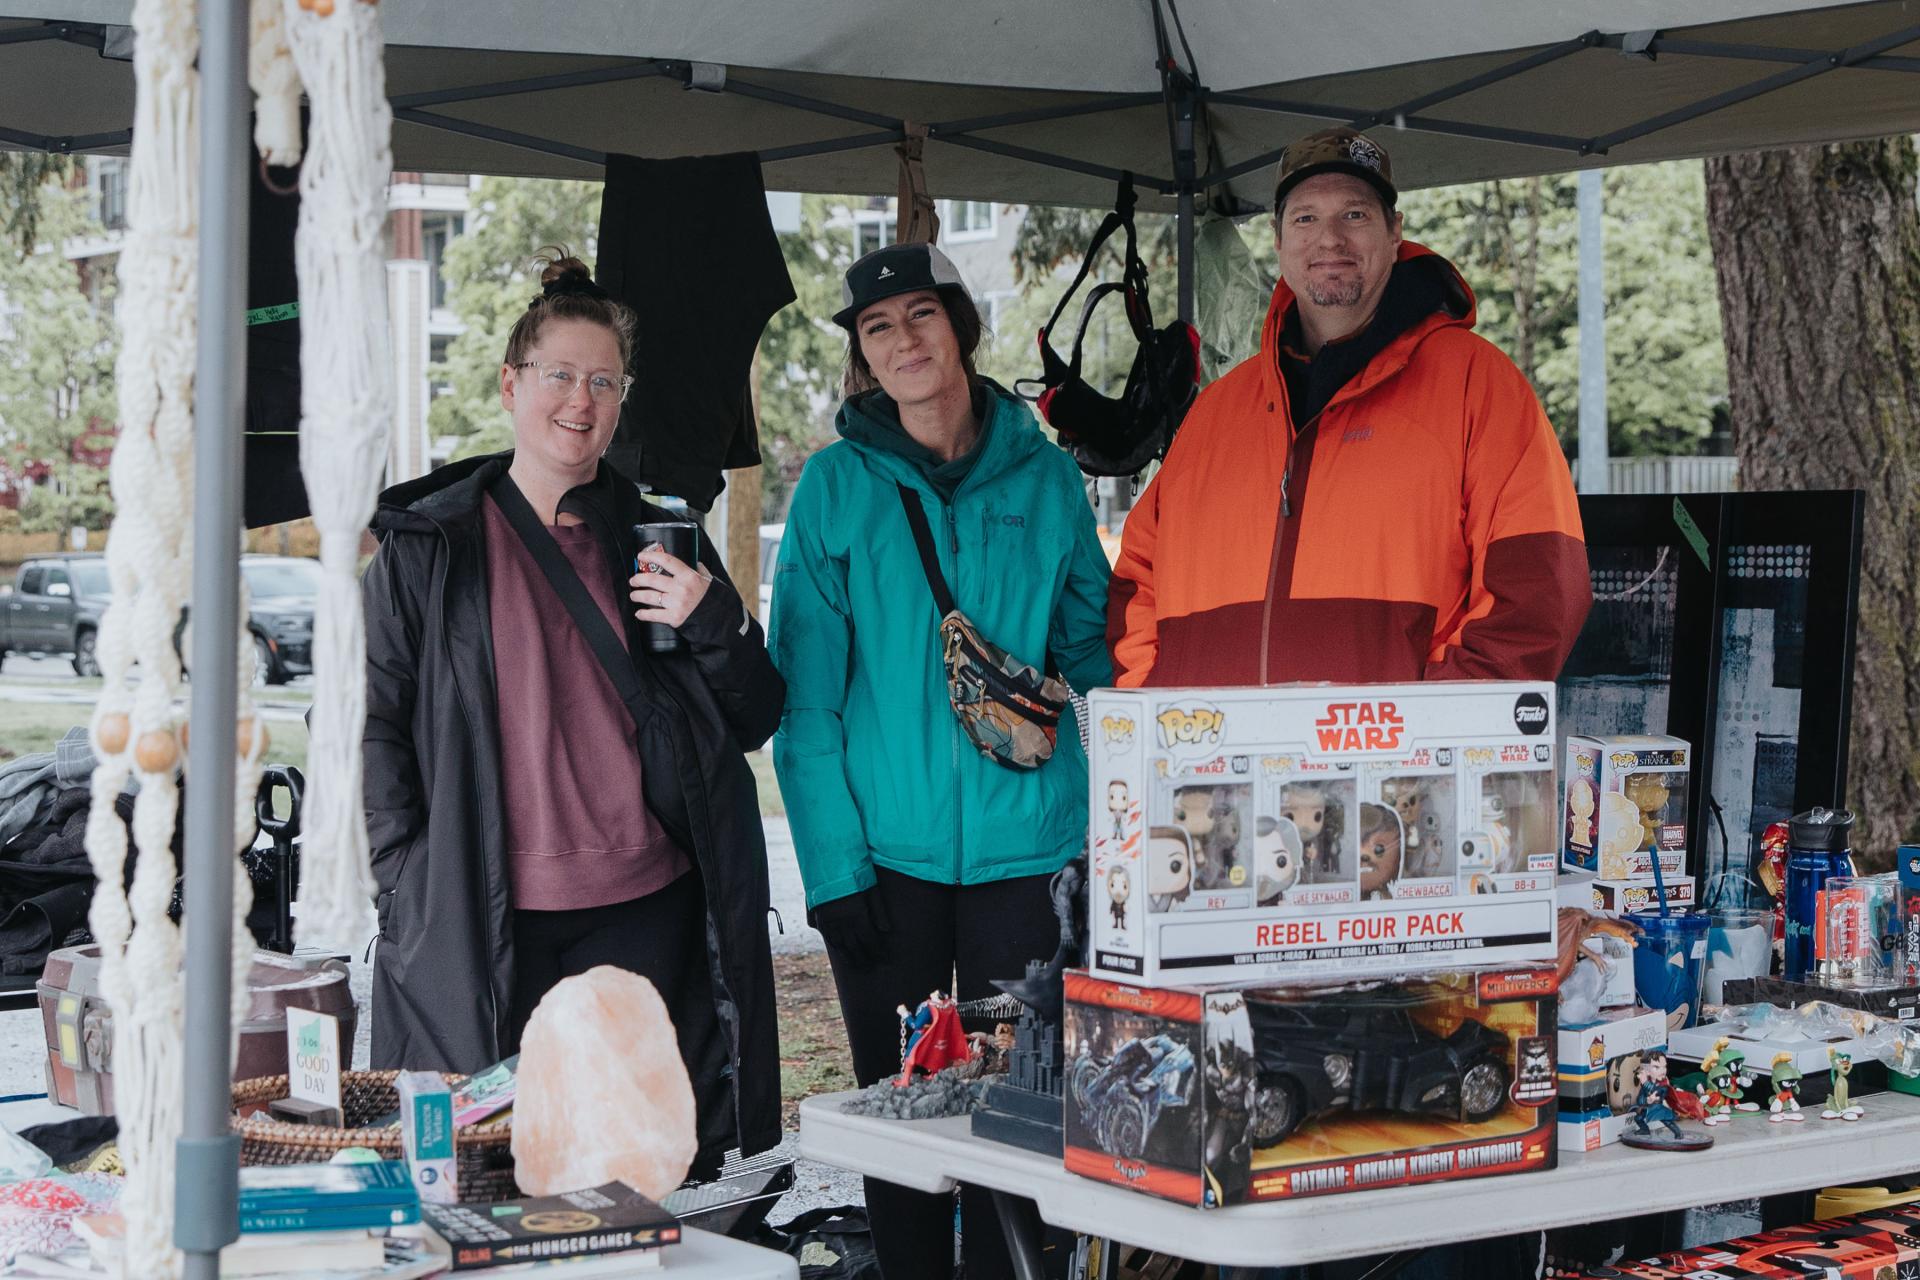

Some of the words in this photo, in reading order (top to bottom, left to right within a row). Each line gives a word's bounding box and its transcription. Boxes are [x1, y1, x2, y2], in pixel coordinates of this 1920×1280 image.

[1315, 702, 1404, 726] STAR
[1515, 706, 1547, 723] Funko
[1102, 716, 1135, 743] POP!
[1156, 709, 1224, 748] POP!
[1316, 726, 1404, 751] WARS
[1501, 745, 1530, 754] STAR
[1501, 752, 1530, 763] WARS
[1535, 745, 1550, 761] 196
[1194, 763, 1226, 774] WARS
[1401, 756, 1432, 767] WARS
[1609, 753, 1638, 769] POP!
[1663, 830, 1684, 840] MARVEL
[1397, 884, 1451, 898] CHEWBACCA
[1514, 880, 1537, 890] BB-8
[1679, 886, 1691, 899] 379
[1207, 896, 1227, 909] REY
[1256, 922, 1327, 947] REBEL
[1338, 917, 1396, 941] FOUR
[1407, 911, 1464, 936] PACK
[1367, 945, 1377, 956] LA
[1487, 978, 1549, 994] MULTIVERSE
[296, 1055, 330, 1074] GOOD
[304, 1075, 326, 1094] DAY
[1290, 1165, 1350, 1193] BATMAN:
[1354, 1157, 1406, 1184] ARKHAM
[1410, 1151, 1454, 1176] KNIGHT
[1458, 1141, 1523, 1169] BATMOBILE
[458, 1247, 492, 1265] COLLINS
[513, 1244, 530, 1257] THE
[532, 1235, 587, 1256] HUNGER
[589, 1231, 633, 1251] GAMES
